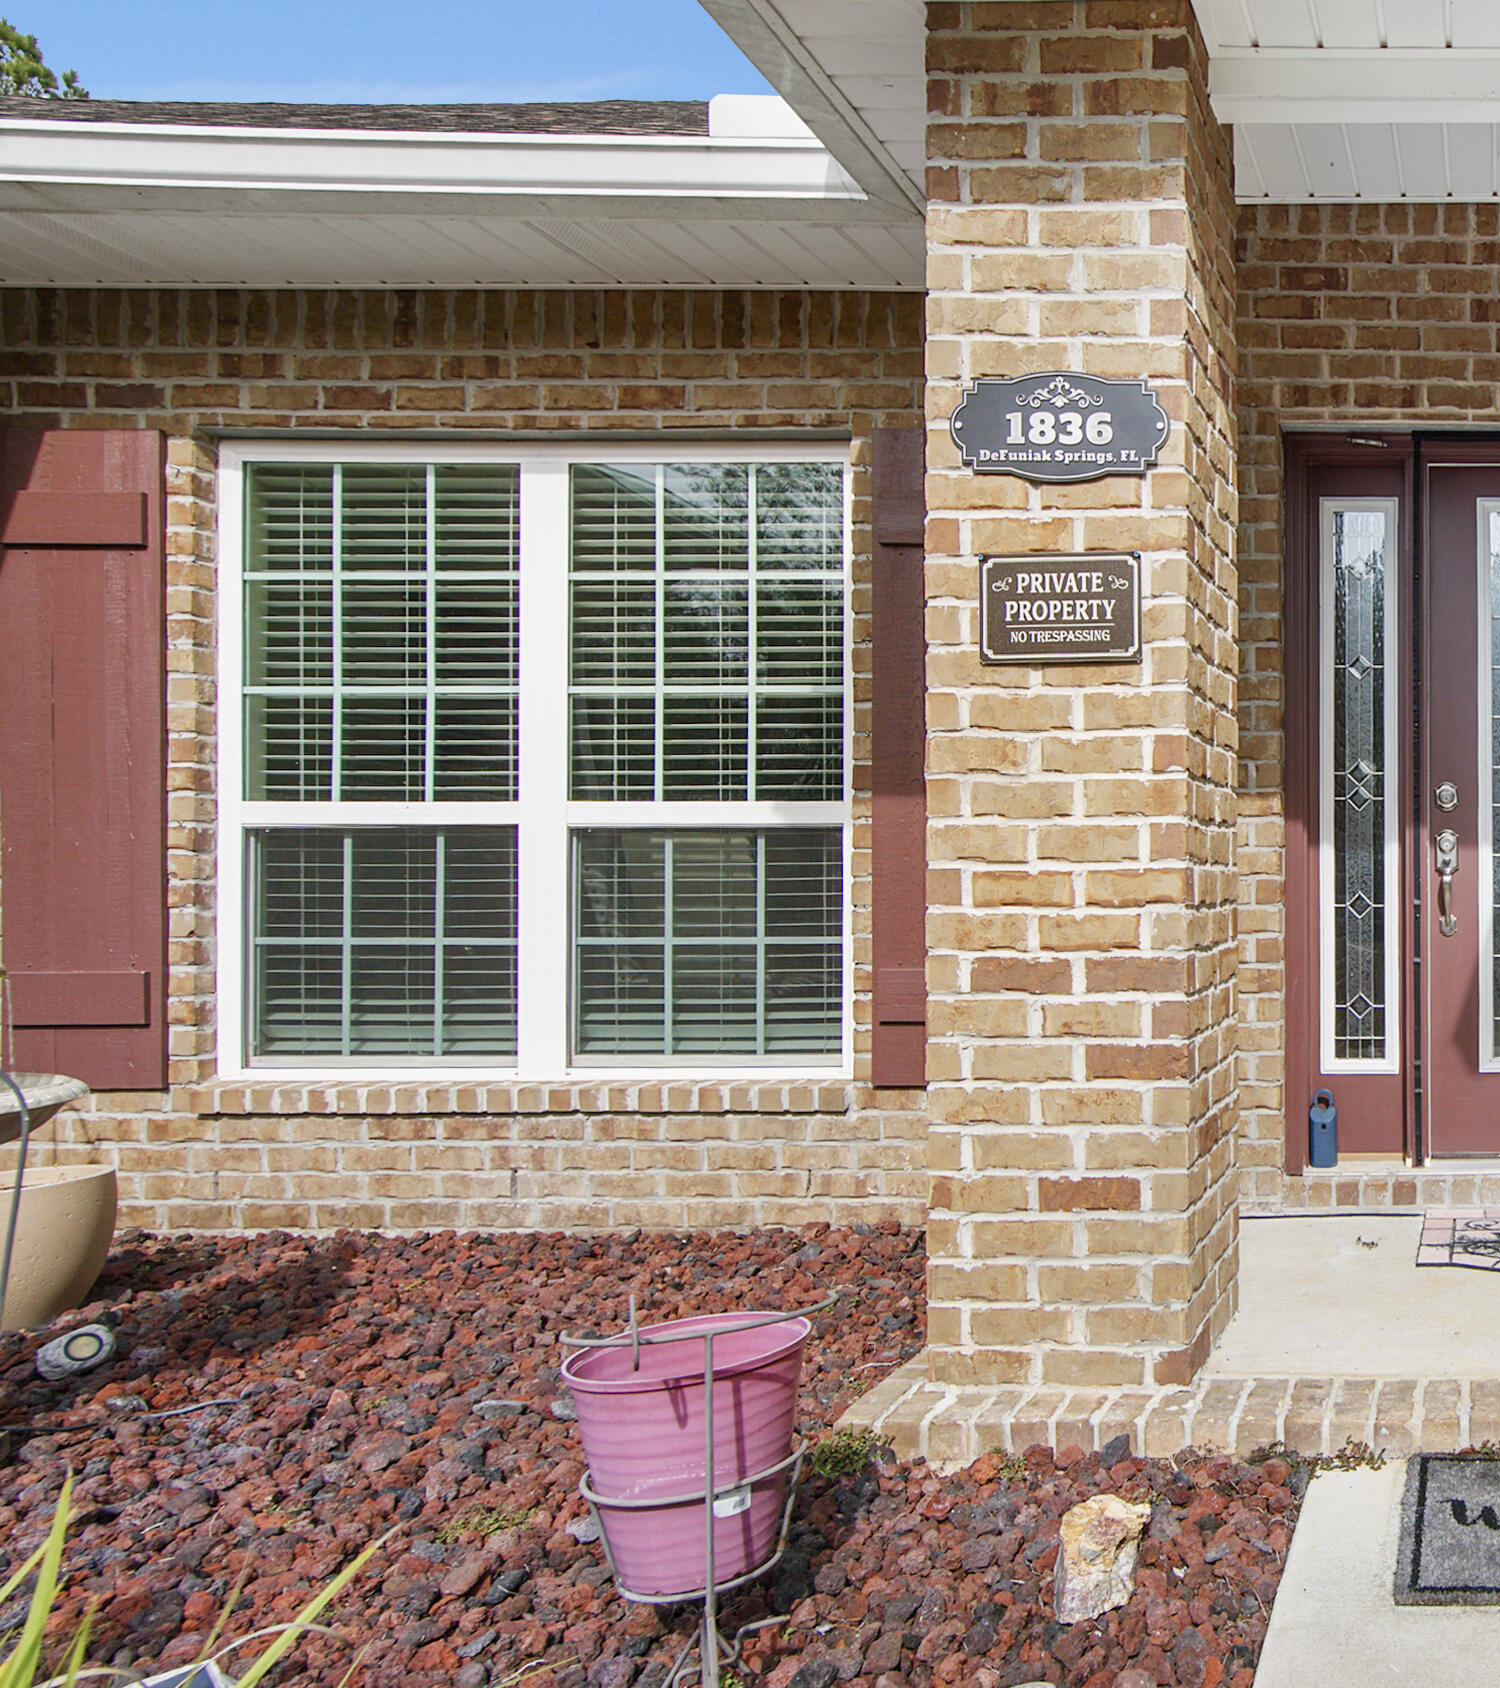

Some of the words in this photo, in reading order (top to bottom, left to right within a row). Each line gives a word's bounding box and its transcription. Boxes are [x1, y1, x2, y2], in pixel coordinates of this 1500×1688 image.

[1005, 411, 1113, 445] 1836
[979, 449, 1051, 462] DeFuniak
[1054, 449, 1118, 465] Springs,
[1120, 449, 1139, 462] FL
[1016, 571, 1104, 594] PRIVATE
[1004, 598, 1116, 622] PROPERTY
[1010, 630, 1028, 643] NO
[1028, 629, 1111, 643] TRESPASSING
